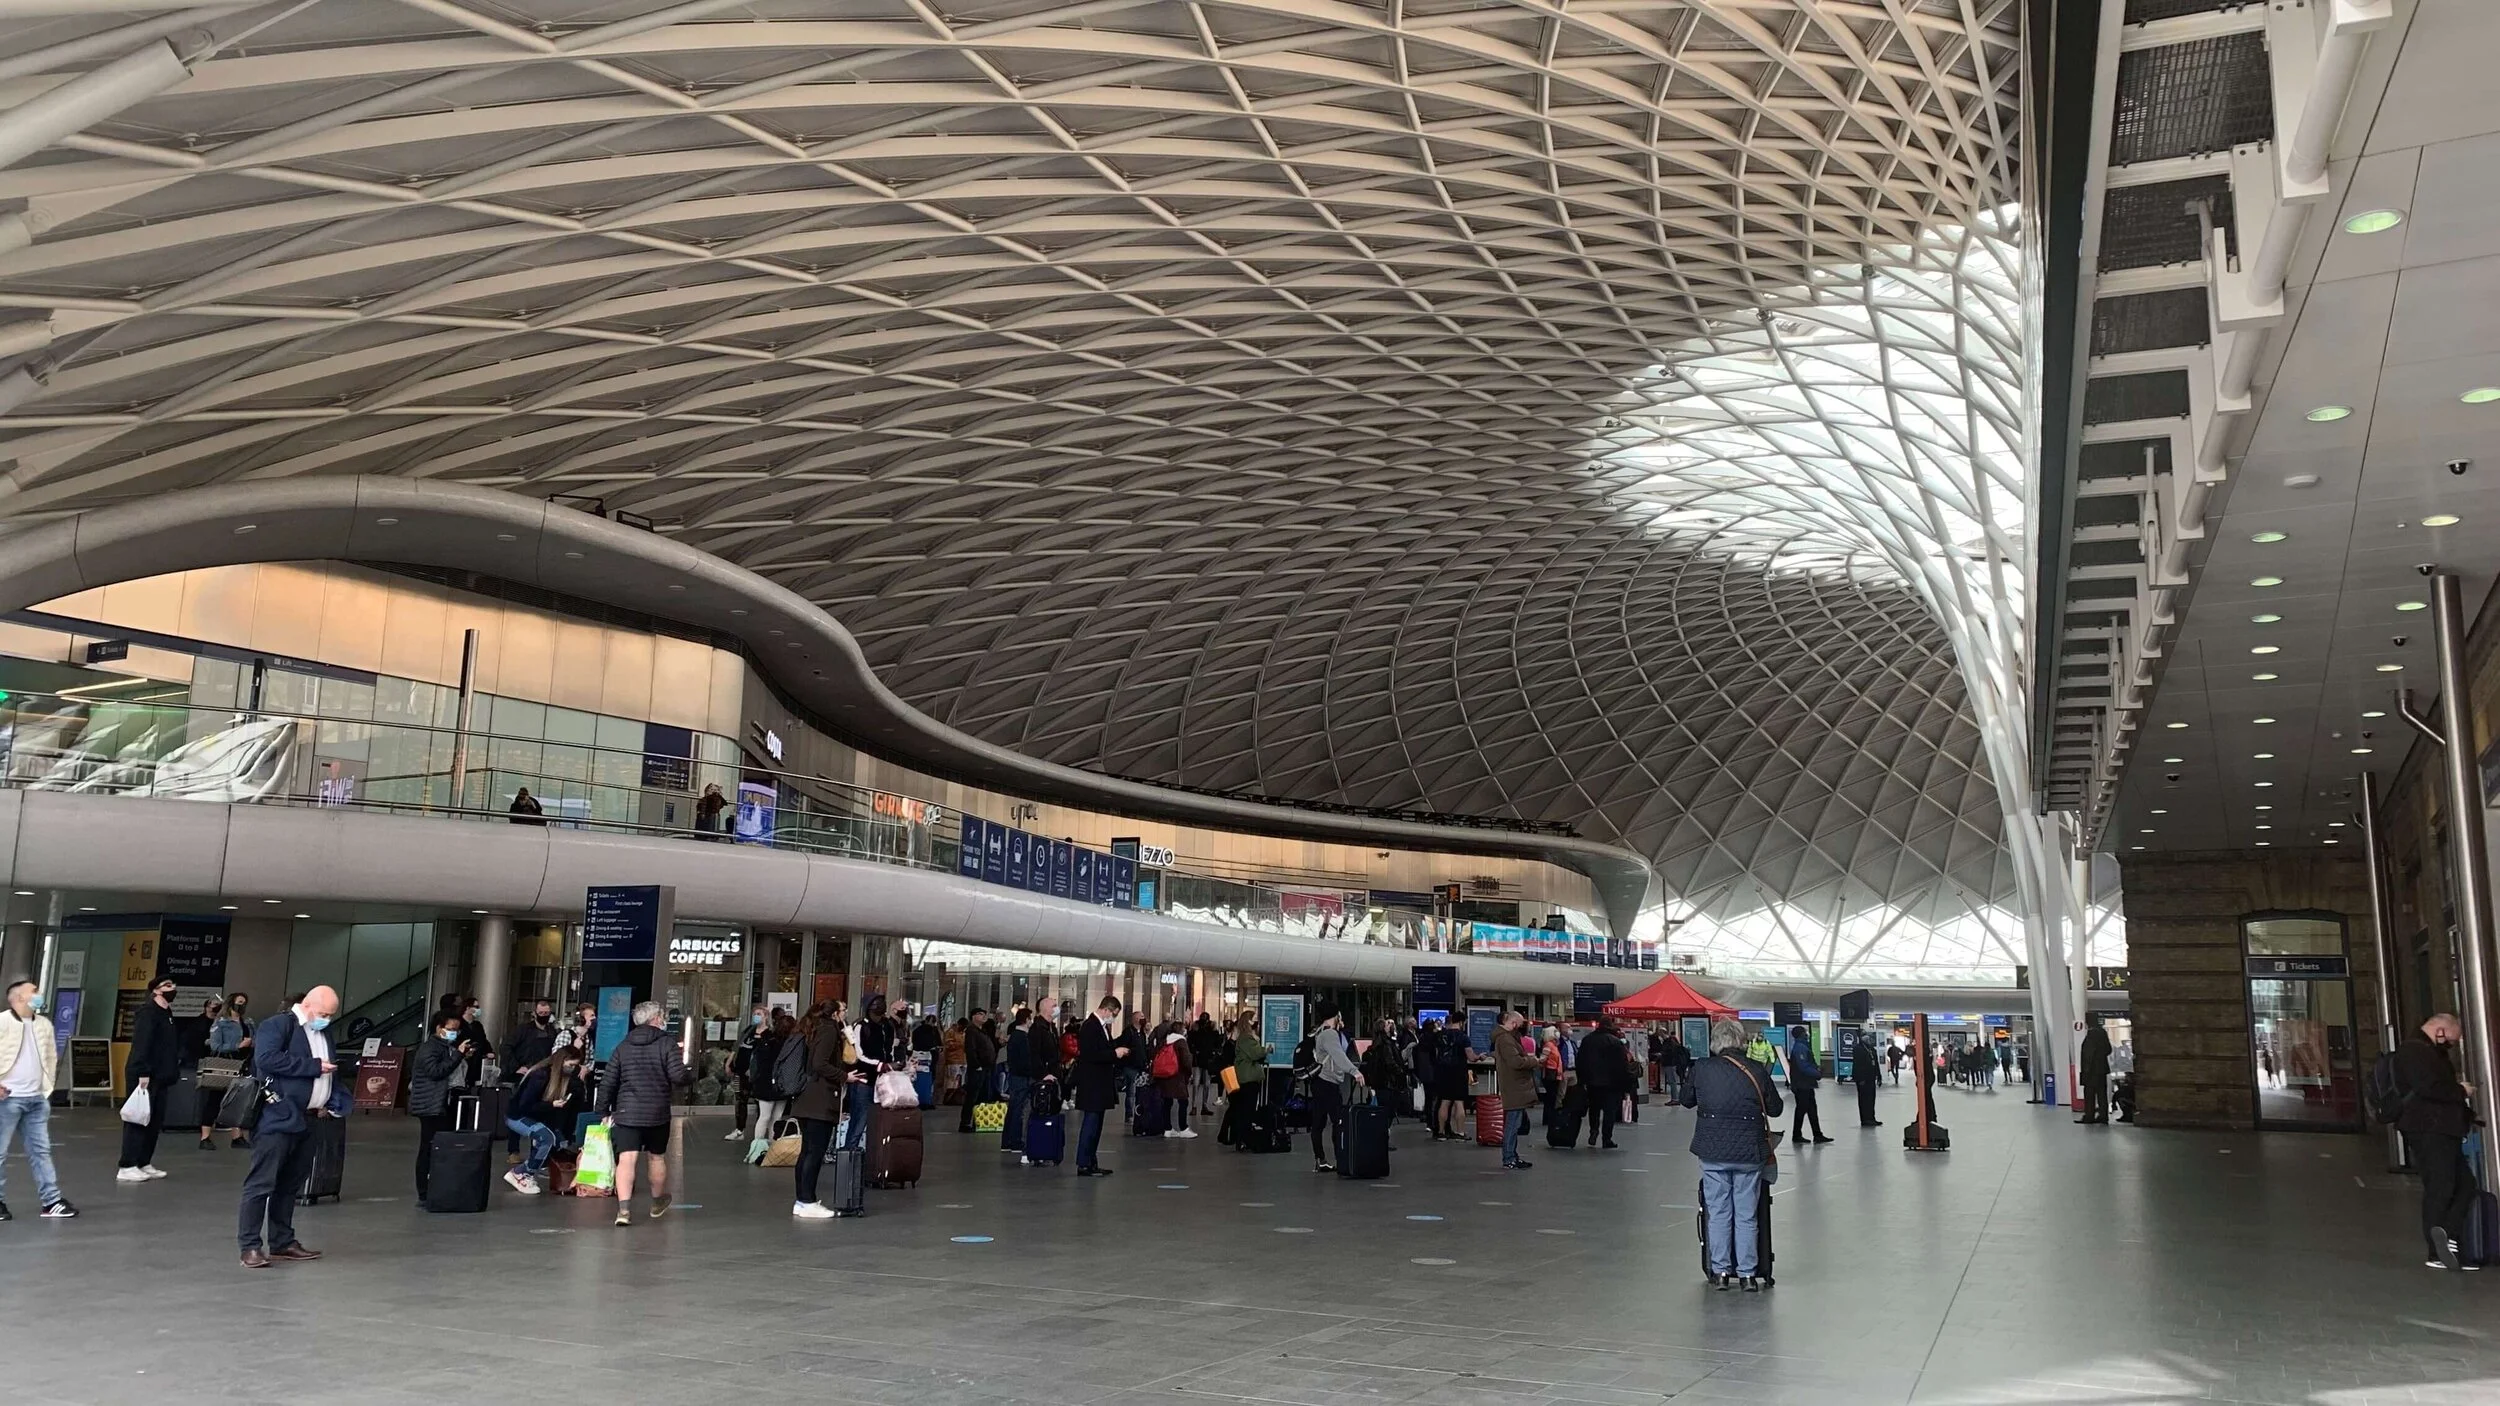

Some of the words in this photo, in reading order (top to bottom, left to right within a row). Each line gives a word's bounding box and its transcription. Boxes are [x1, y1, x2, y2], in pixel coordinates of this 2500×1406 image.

[1139, 845, 1175, 866] EZZO
[166, 934, 200, 943] Platforms
[167, 957, 190, 966] Dining
[668, 952, 724, 965] COFFEE
[169, 966, 196, 976] Seating
[2289, 962, 2320, 971] Tickets
[127, 967, 147, 981] Lifts
[1602, 1007, 1626, 1016] LNER
